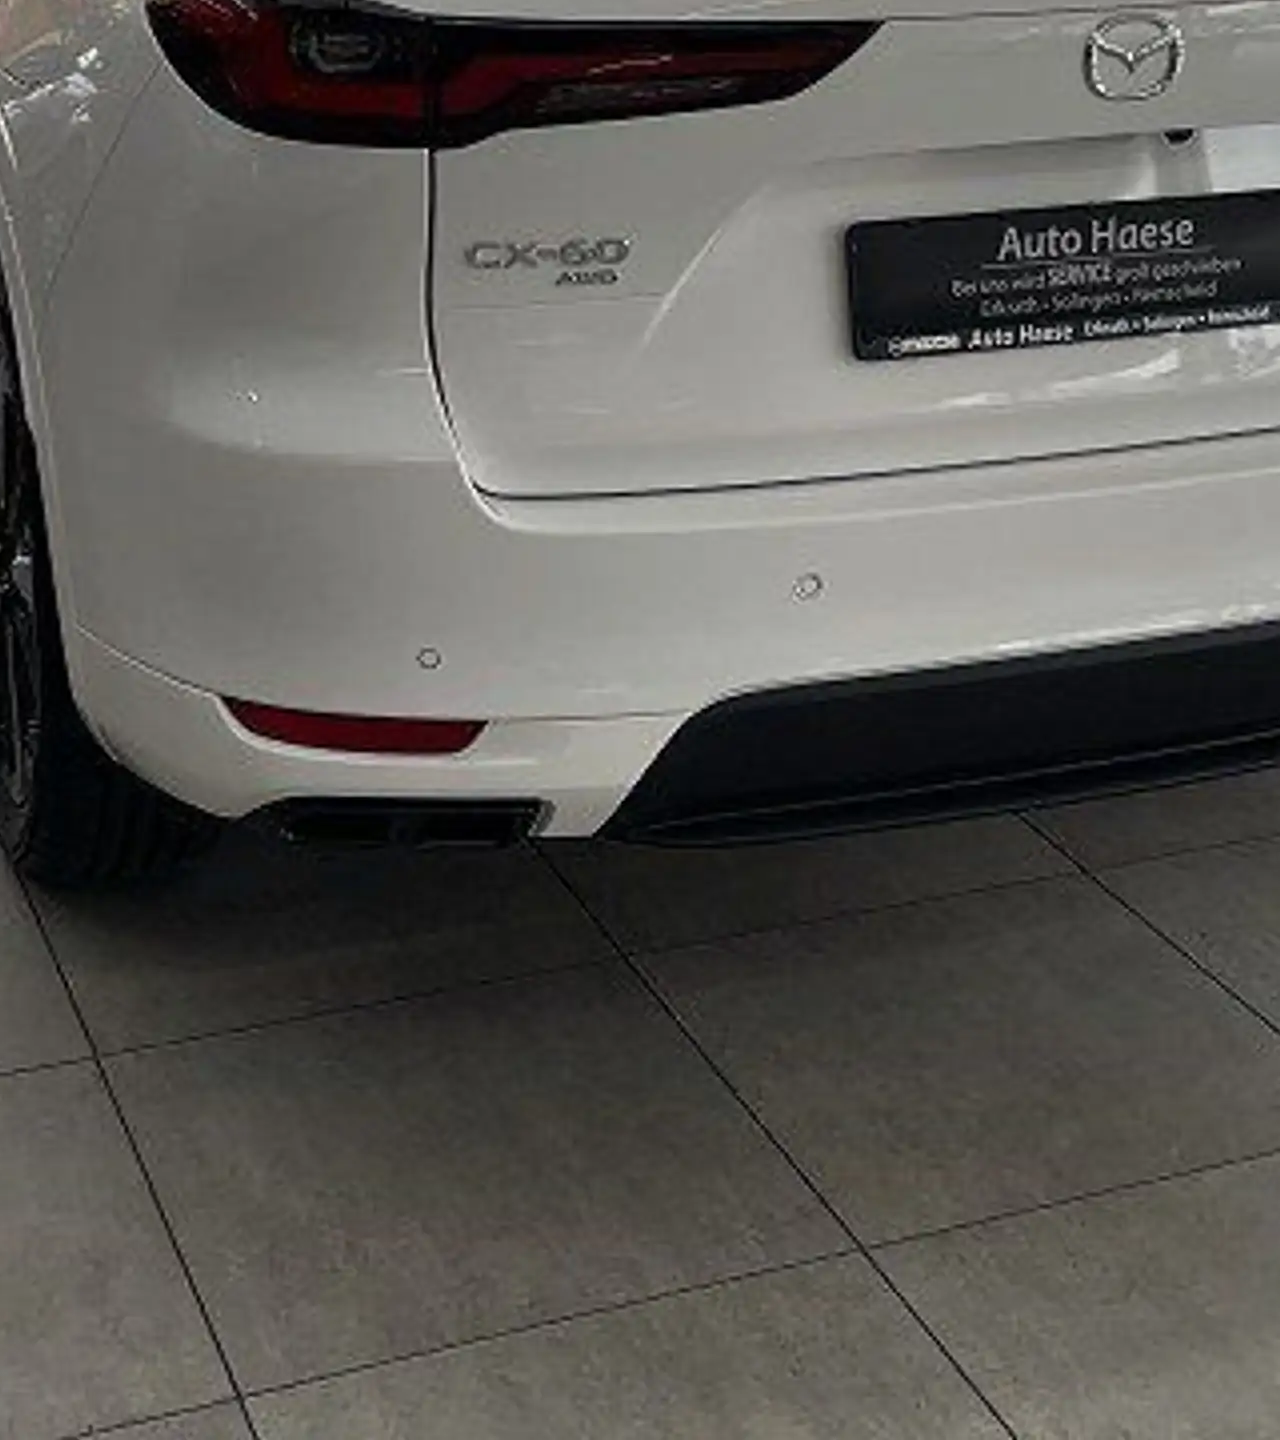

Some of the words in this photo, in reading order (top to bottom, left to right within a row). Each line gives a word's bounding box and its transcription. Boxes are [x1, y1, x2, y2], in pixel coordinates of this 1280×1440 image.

[465, 237, 631, 269] CX-60
[996, 225, 1082, 262] Auto
[1090, 216, 1195, 253] Haese
[968, 327, 1015, 350] Auto
